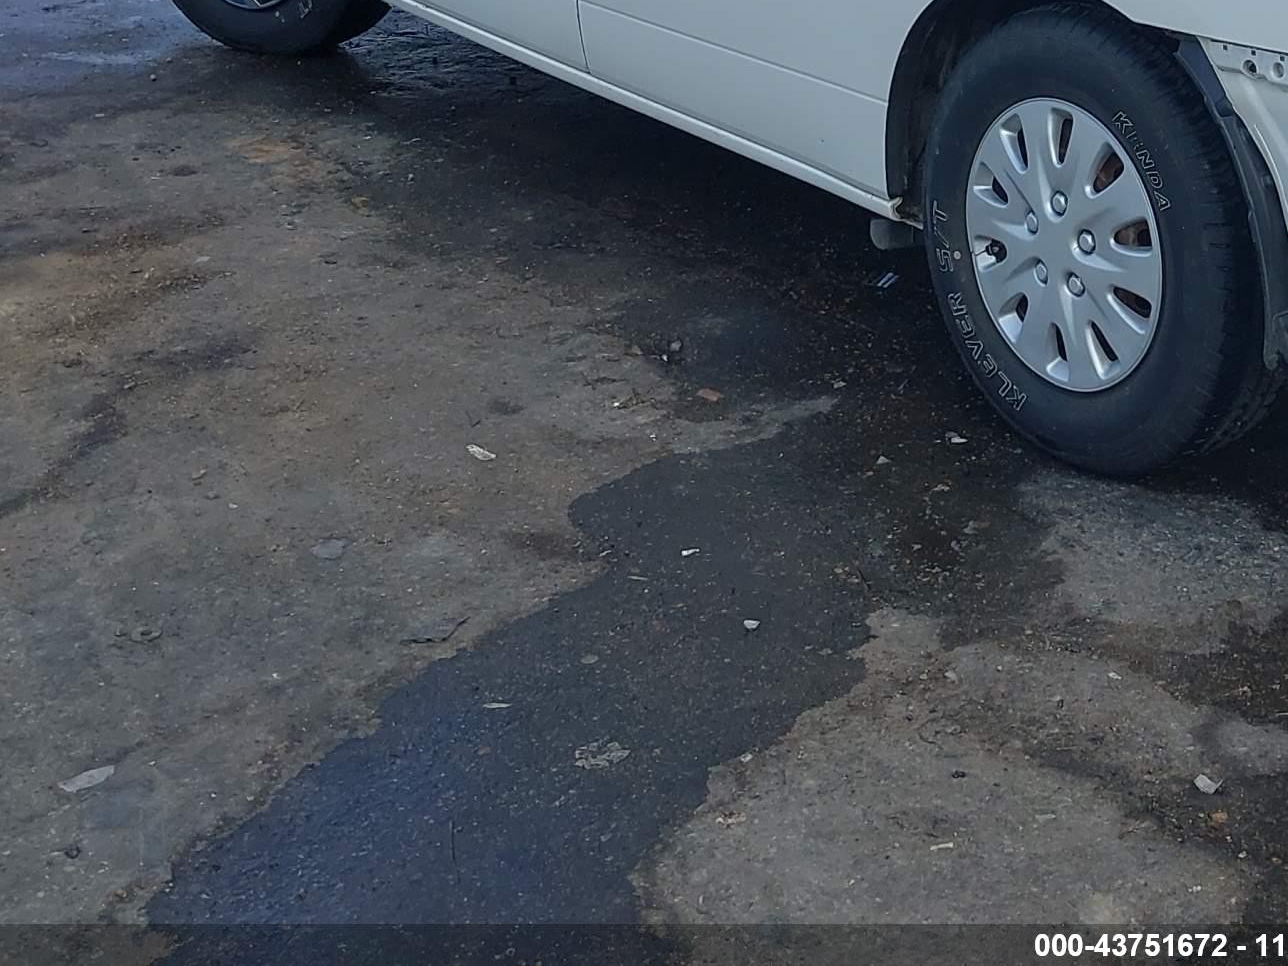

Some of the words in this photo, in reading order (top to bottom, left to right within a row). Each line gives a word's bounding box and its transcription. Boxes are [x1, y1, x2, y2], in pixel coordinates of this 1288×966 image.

[1112, 111, 1171, 211] KENDA
[933, 200, 954, 273] S/T
[947, 291, 1028, 411] KLEVER
